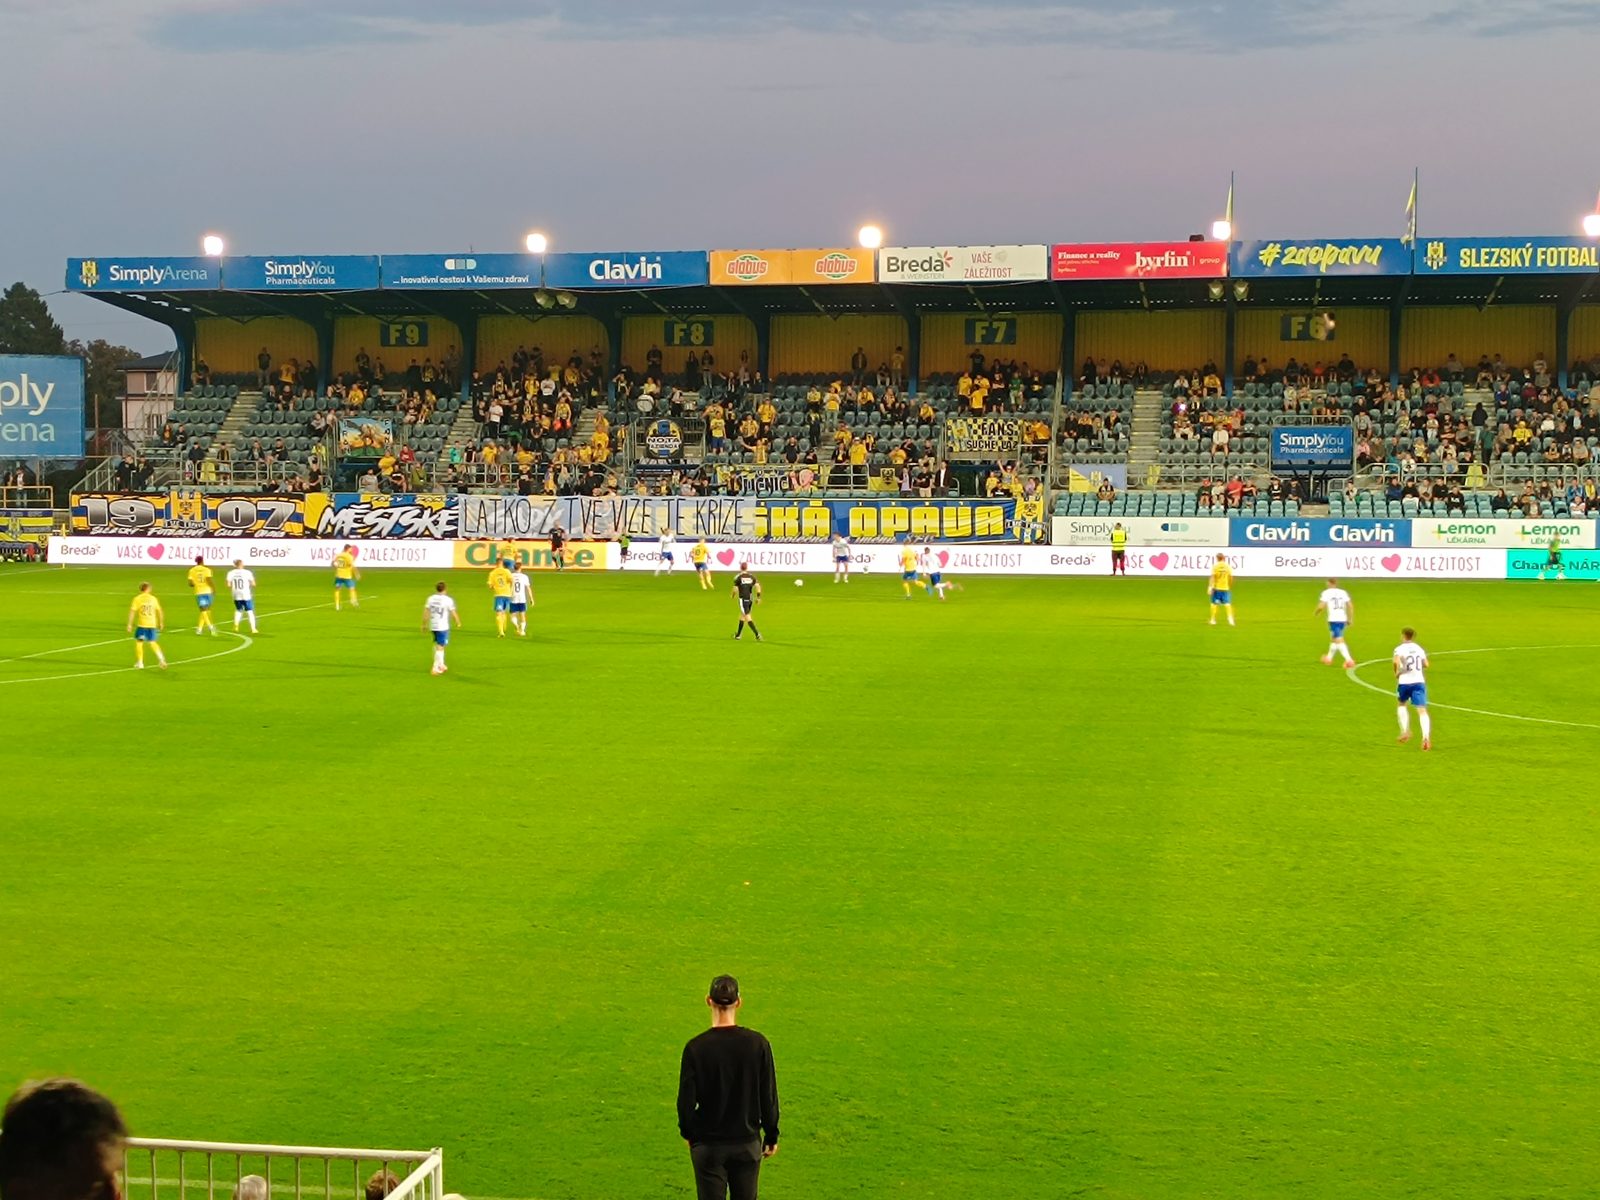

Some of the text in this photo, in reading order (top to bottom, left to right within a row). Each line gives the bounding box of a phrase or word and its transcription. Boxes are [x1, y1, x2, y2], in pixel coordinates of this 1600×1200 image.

[971, 250, 992, 264] VAŠE
[1096, 250, 1120, 260] reality
[1135, 251, 1188, 270] byrfin
[1460, 243, 1599, 268] SLEZSKÝ FOTBAL
[265, 261, 334, 278] SimplyYou
[589, 256, 662, 280] Clavin
[887, 256, 944, 273] Breda
[110, 265, 208, 284] SimplyArena
[266, 277, 336, 285] Pharmaceuticals
[389, 324, 419, 345] F9
[673, 323, 704, 345] F8
[975, 321, 1007, 343] F7
[0, 422, 55, 441] ena
[981, 422, 1015, 437] FANS
[647, 437, 681, 445] NOTA
[1280, 433, 1344, 448] SimplyYou
[79, 498, 296, 530] 19 07
[612, 498, 650, 534] VIZE
[696, 499, 745, 535] KRIZE
[1246, 522, 1394, 542] Clavin Clavin
[1438, 524, 1496, 535] Lemon
[1522, 525, 1580, 535] Lemon
[1447, 536, 1486, 544] LÉKÁRNA
[60, 544, 96, 555] Breda
[250, 547, 286, 558] Breda
[1050, 554, 1091, 566] Breda
[1275, 556, 1317, 567] Breda
[233, 579, 244, 590] 10
[514, 581, 521, 592] 8
